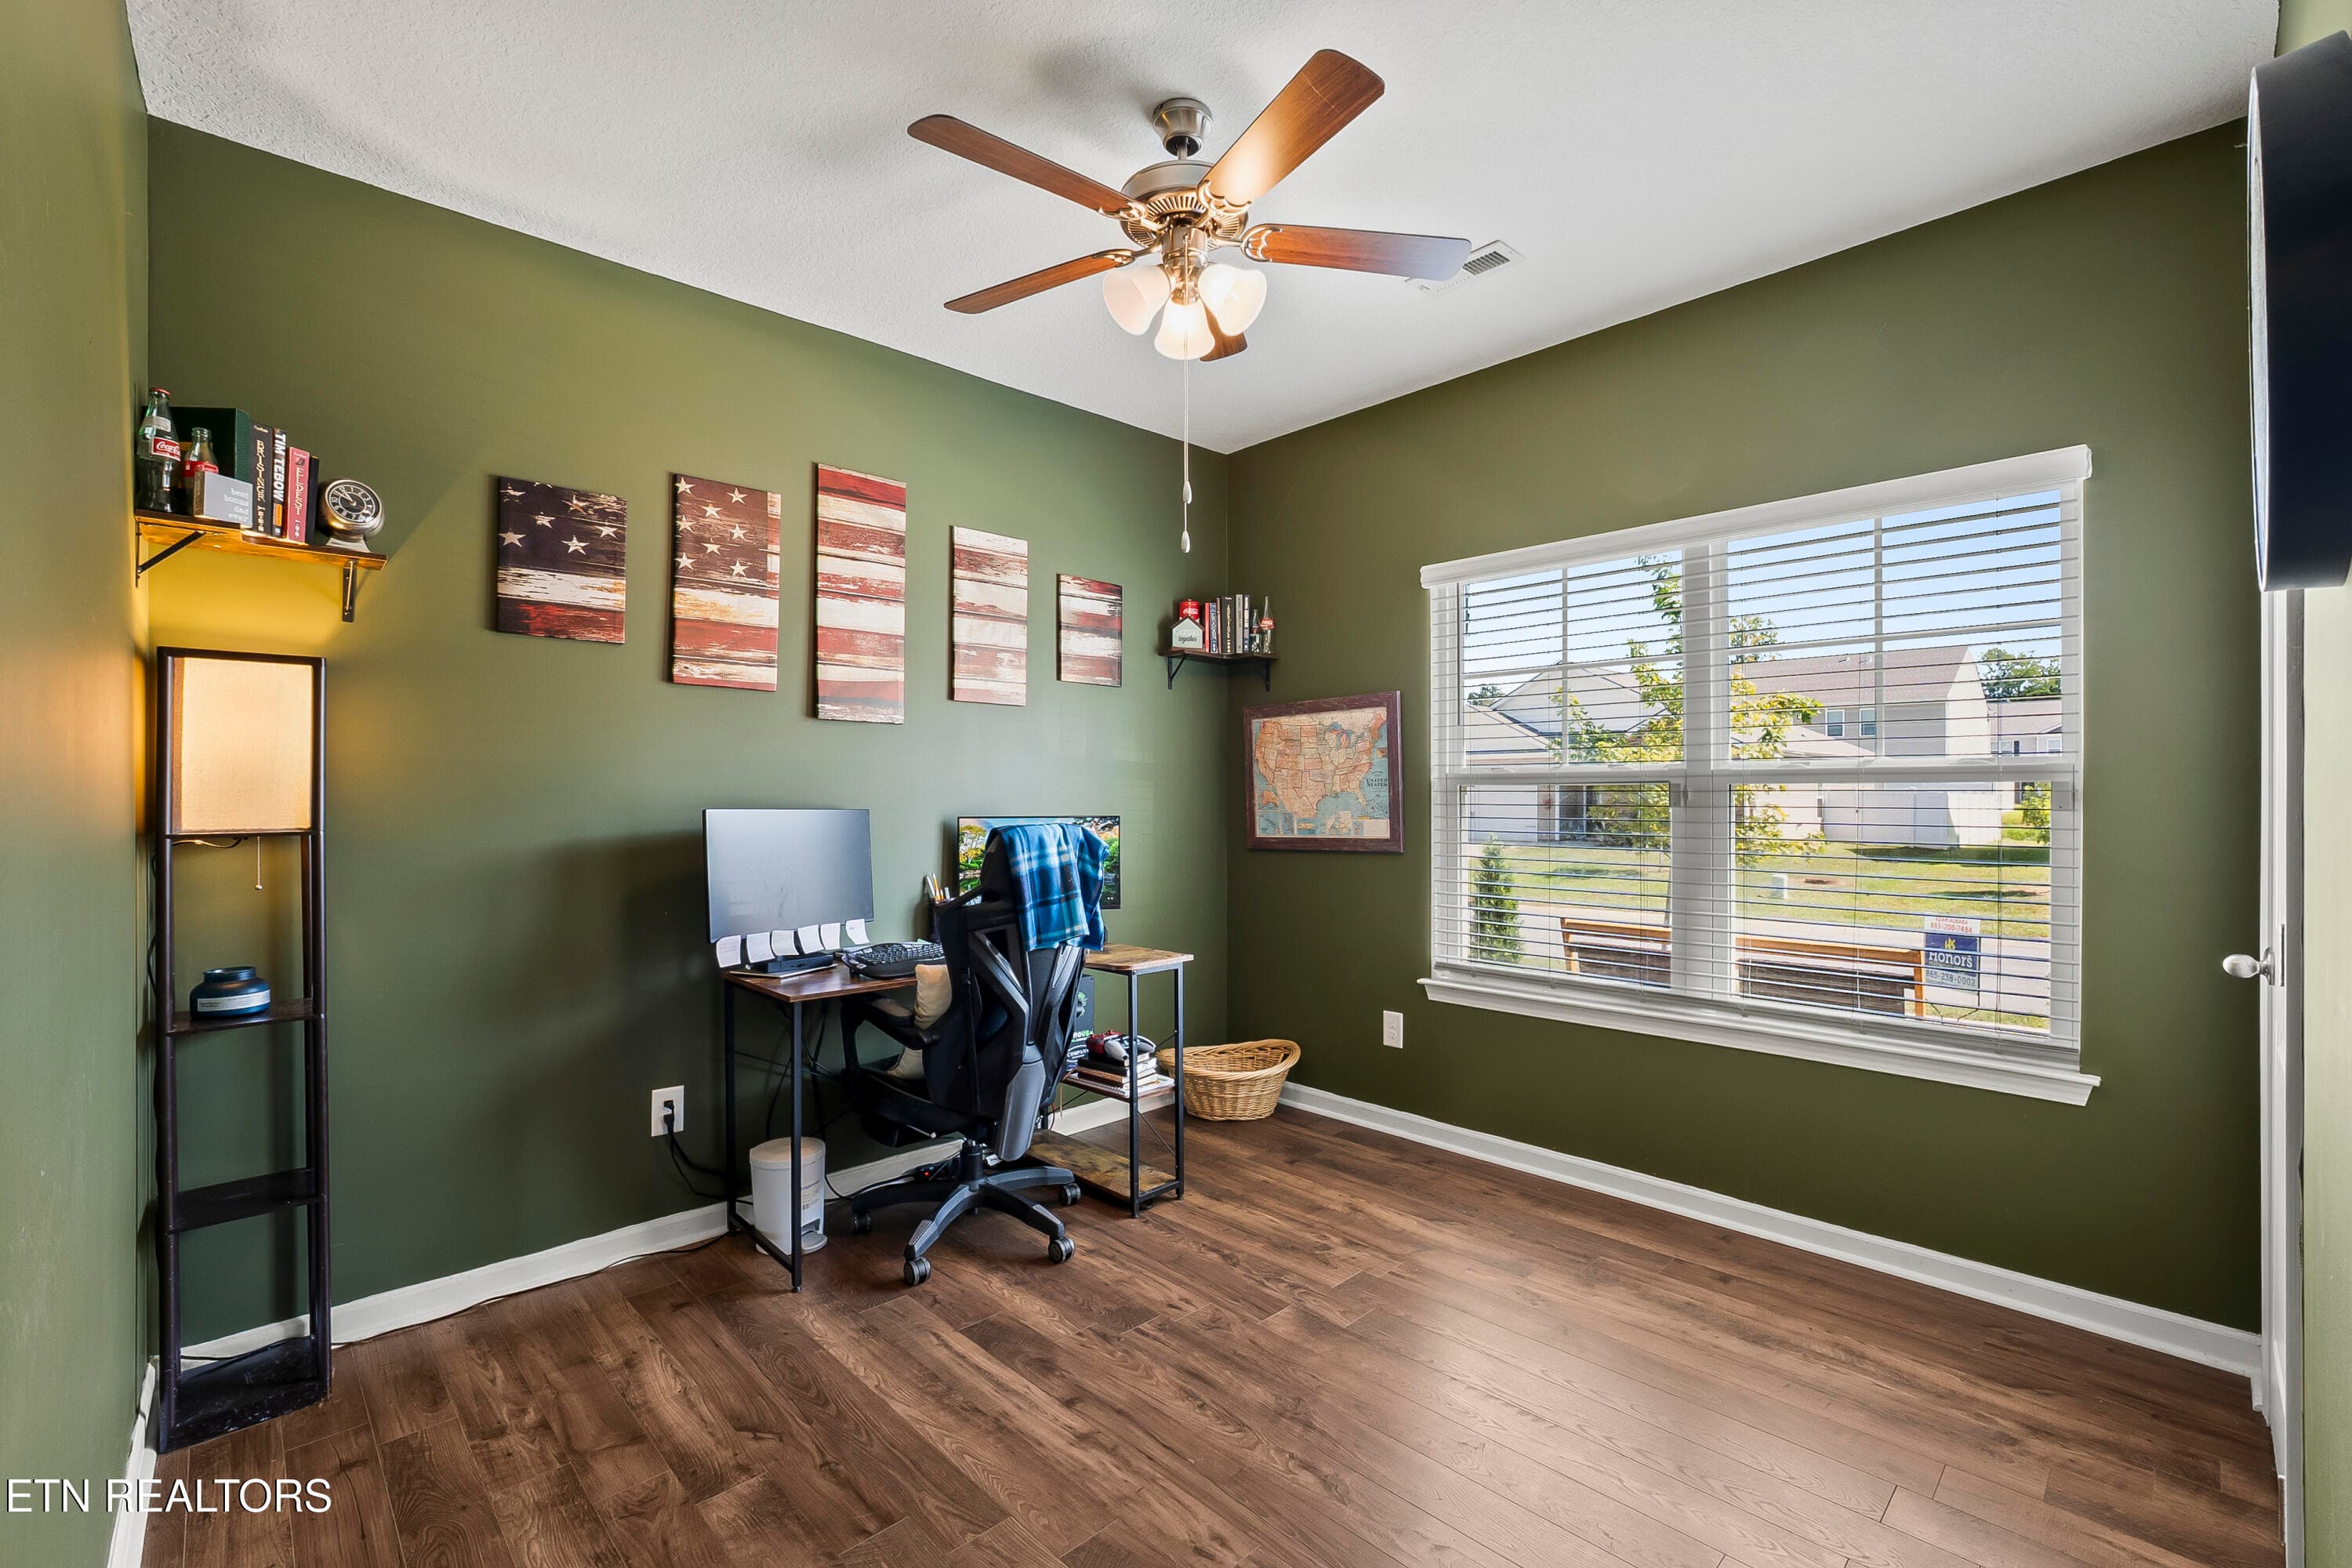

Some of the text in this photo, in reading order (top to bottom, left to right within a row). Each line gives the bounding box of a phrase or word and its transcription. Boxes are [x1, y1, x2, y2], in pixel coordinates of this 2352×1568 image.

[274, 434, 286, 455] TIM
[273, 459, 285, 502] TEBOW
[234, 505, 249, 514] dad
